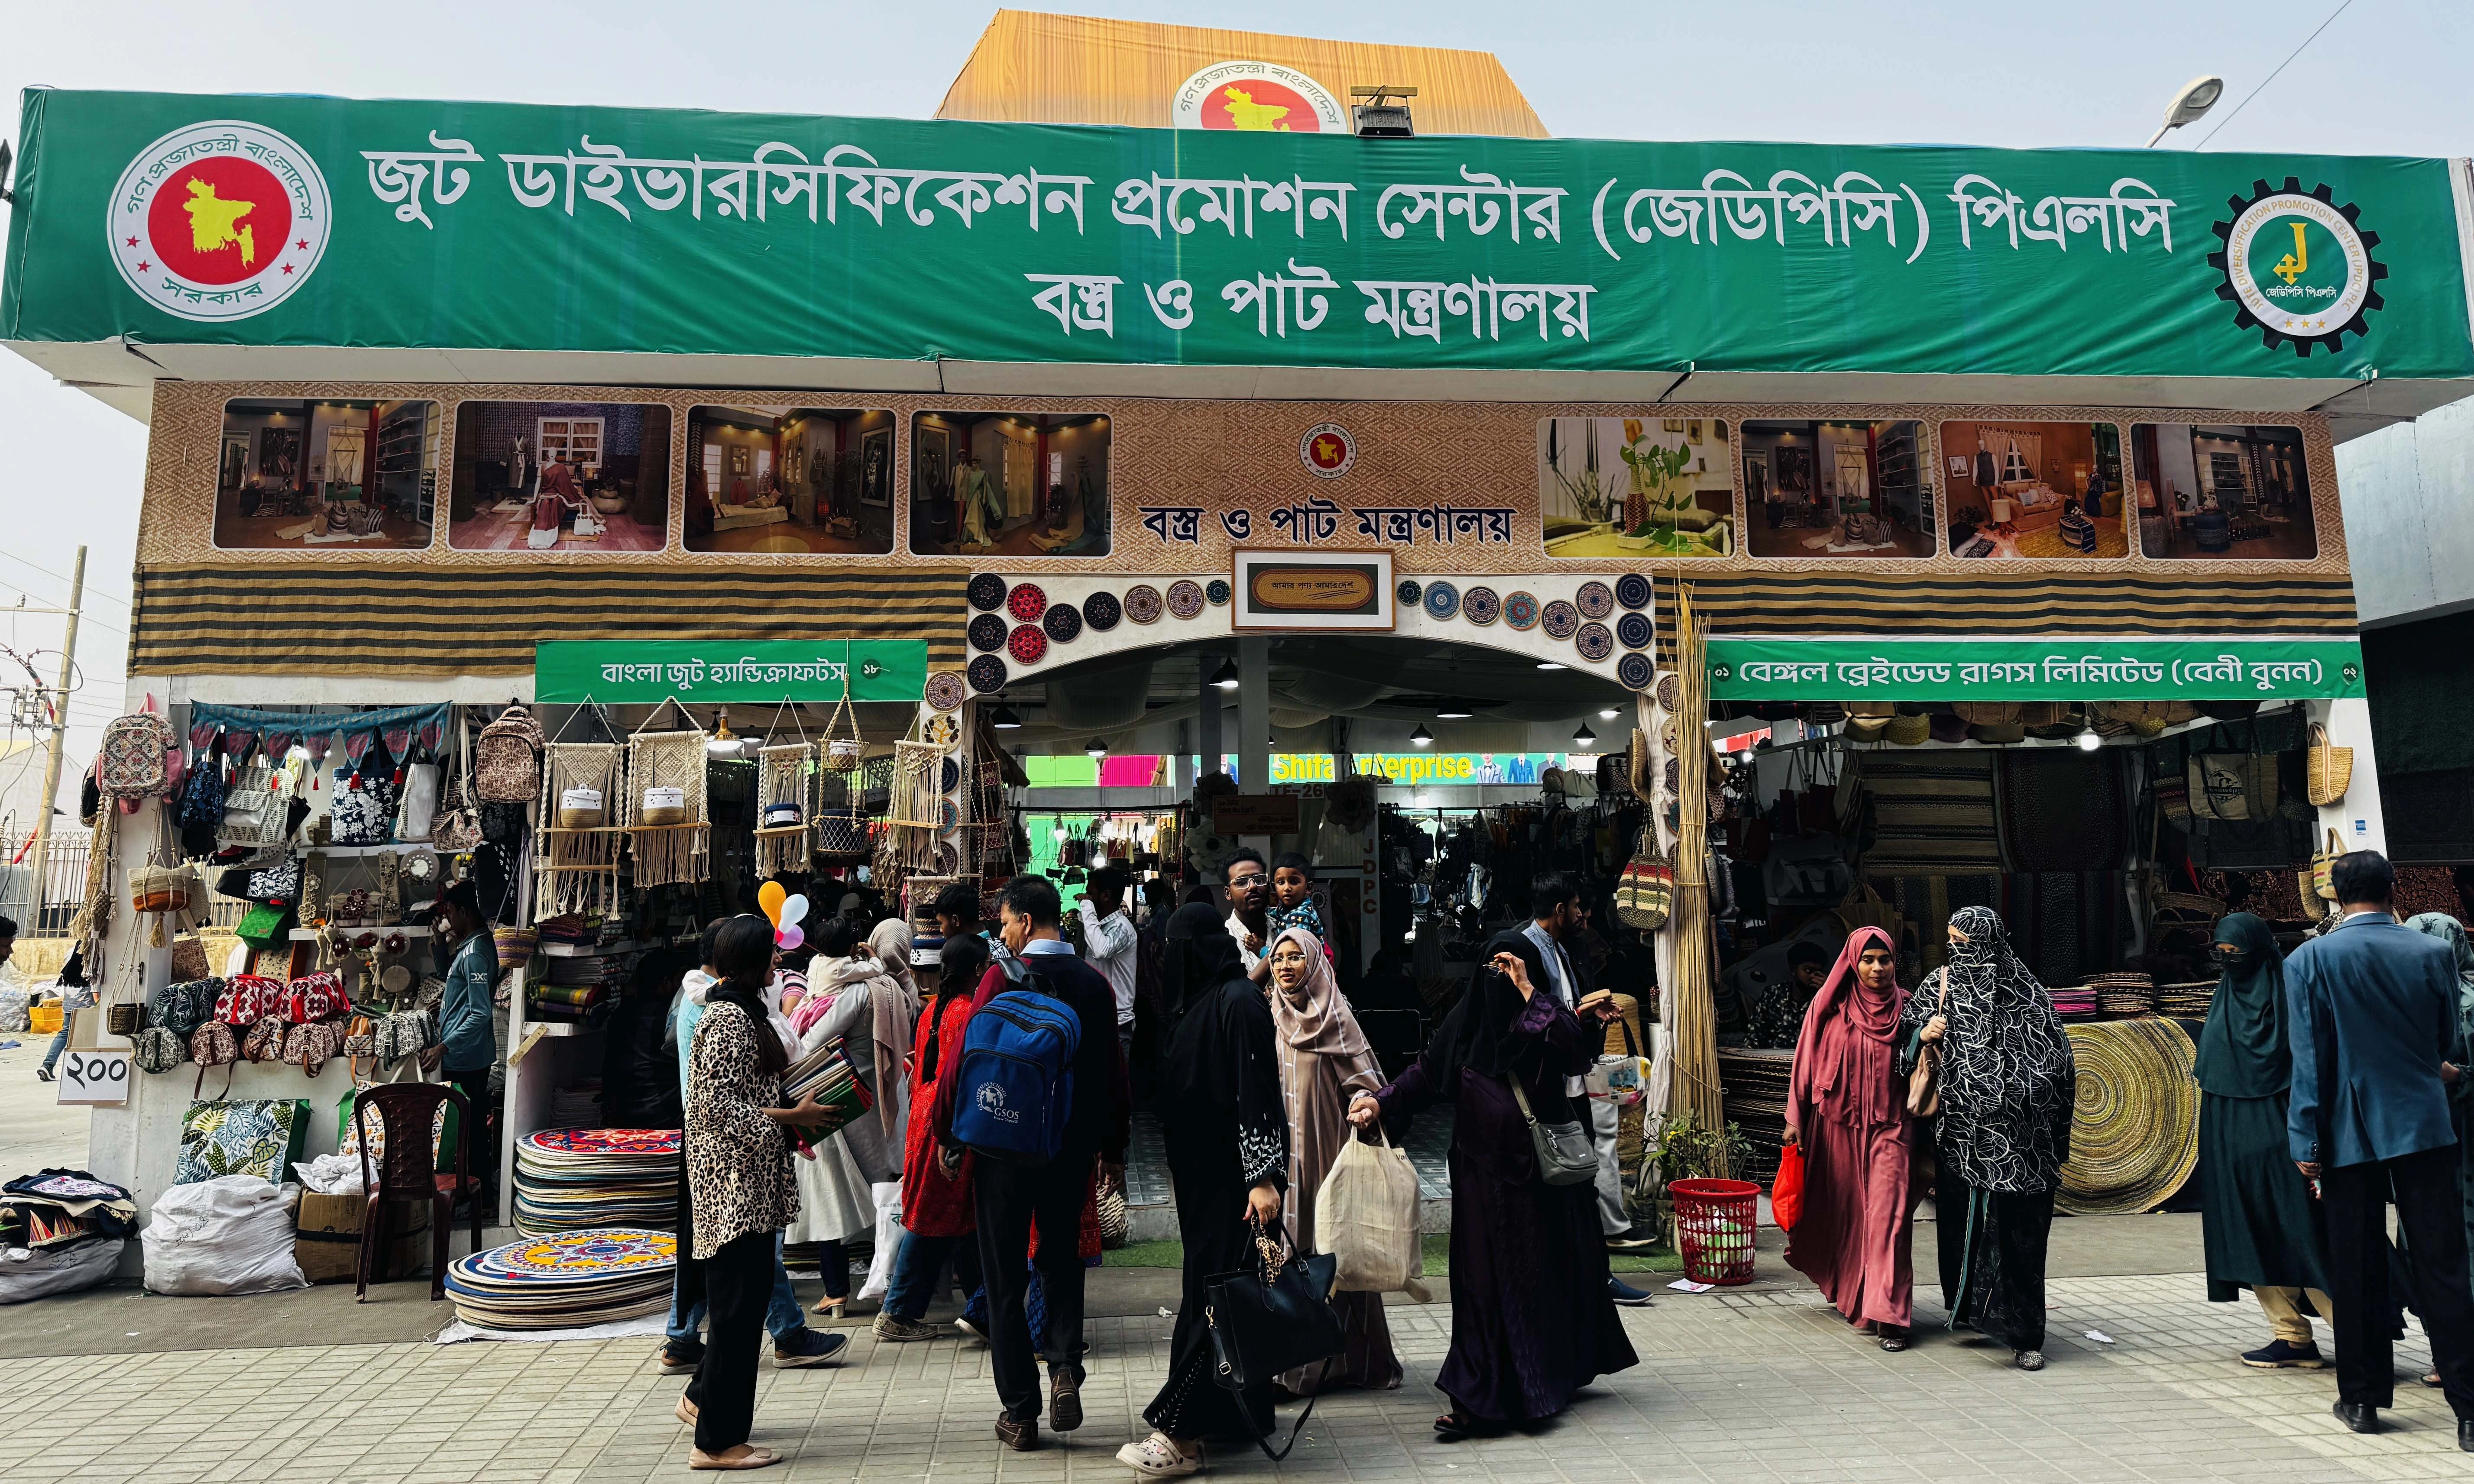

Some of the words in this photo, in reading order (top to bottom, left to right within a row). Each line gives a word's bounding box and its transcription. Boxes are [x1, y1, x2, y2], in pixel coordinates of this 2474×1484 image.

[1272, 68, 1339, 124] বাংলাদেশ
[245, 141, 313, 221] বাংলাদেশ
[359, 129, 485, 230] জুট
[498, 134, 1095, 236] ডাইভারসিফিকেশন
[1111, 170, 1357, 242] প্রমোশন
[1376, 164, 1570, 245] সেন্টার
[1592, 168, 1930, 265] (জেডিপিসি)
[1946, 173, 2177, 254] পিএলসি
[2271, 200, 2334, 223] PROMOTION
[2333, 220, 2360, 258] CENTER
[162, 277, 263, 304] সরকার
[2266, 285, 2303, 298] জেডিপিসি
[2306, 285, 2337, 298] পিএলসি
[2350, 260, 2363, 292] (JPDC)
[1023, 273, 1124, 339] বস্ত্র
[1143, 279, 1194, 330] ও
[1221, 257, 1341, 339] পাট
[1351, 273, 1598, 345] মন্ত্রণালয়
[2243, 286, 2265, 310] JUTE
[2342, 292, 2357, 311] PLC
[1332, 427, 1354, 453] বাংলাদেশ
[1315, 468, 1343, 477] সরকার
[1137, 507, 1207, 545] বস্ত্র
[1219, 509, 1251, 540] ও
[1269, 494, 1343, 544] পাট
[1350, 502, 1519, 546] মন্ত্রণালয়
[601, 663, 663, 682] বাংলা
[666, 657, 706, 690] জুট
[864, 664, 879, 674] ১৮
[1714, 667, 1729, 677] ০১
[1739, 662, 1830, 683] বেঙ্গল
[1835, 656, 1952, 687] ব্রেইডেড
[1957, 663, 2037, 685] রাগস
[2041, 655, 2164, 683] লিমিটেড
[2171, 654, 2244, 686] (বেনী
[2247, 658, 2322, 690] বুনন)
[2343, 667, 2357, 678] ০২
[1273, 753, 1334, 780] Shifa
[1352, 753, 1472, 785] nterprise
[1363, 838, 1377, 915] JDPC
[67, 1052, 127, 1090] ২০০
[994, 1108, 1019, 1119] GSOS
